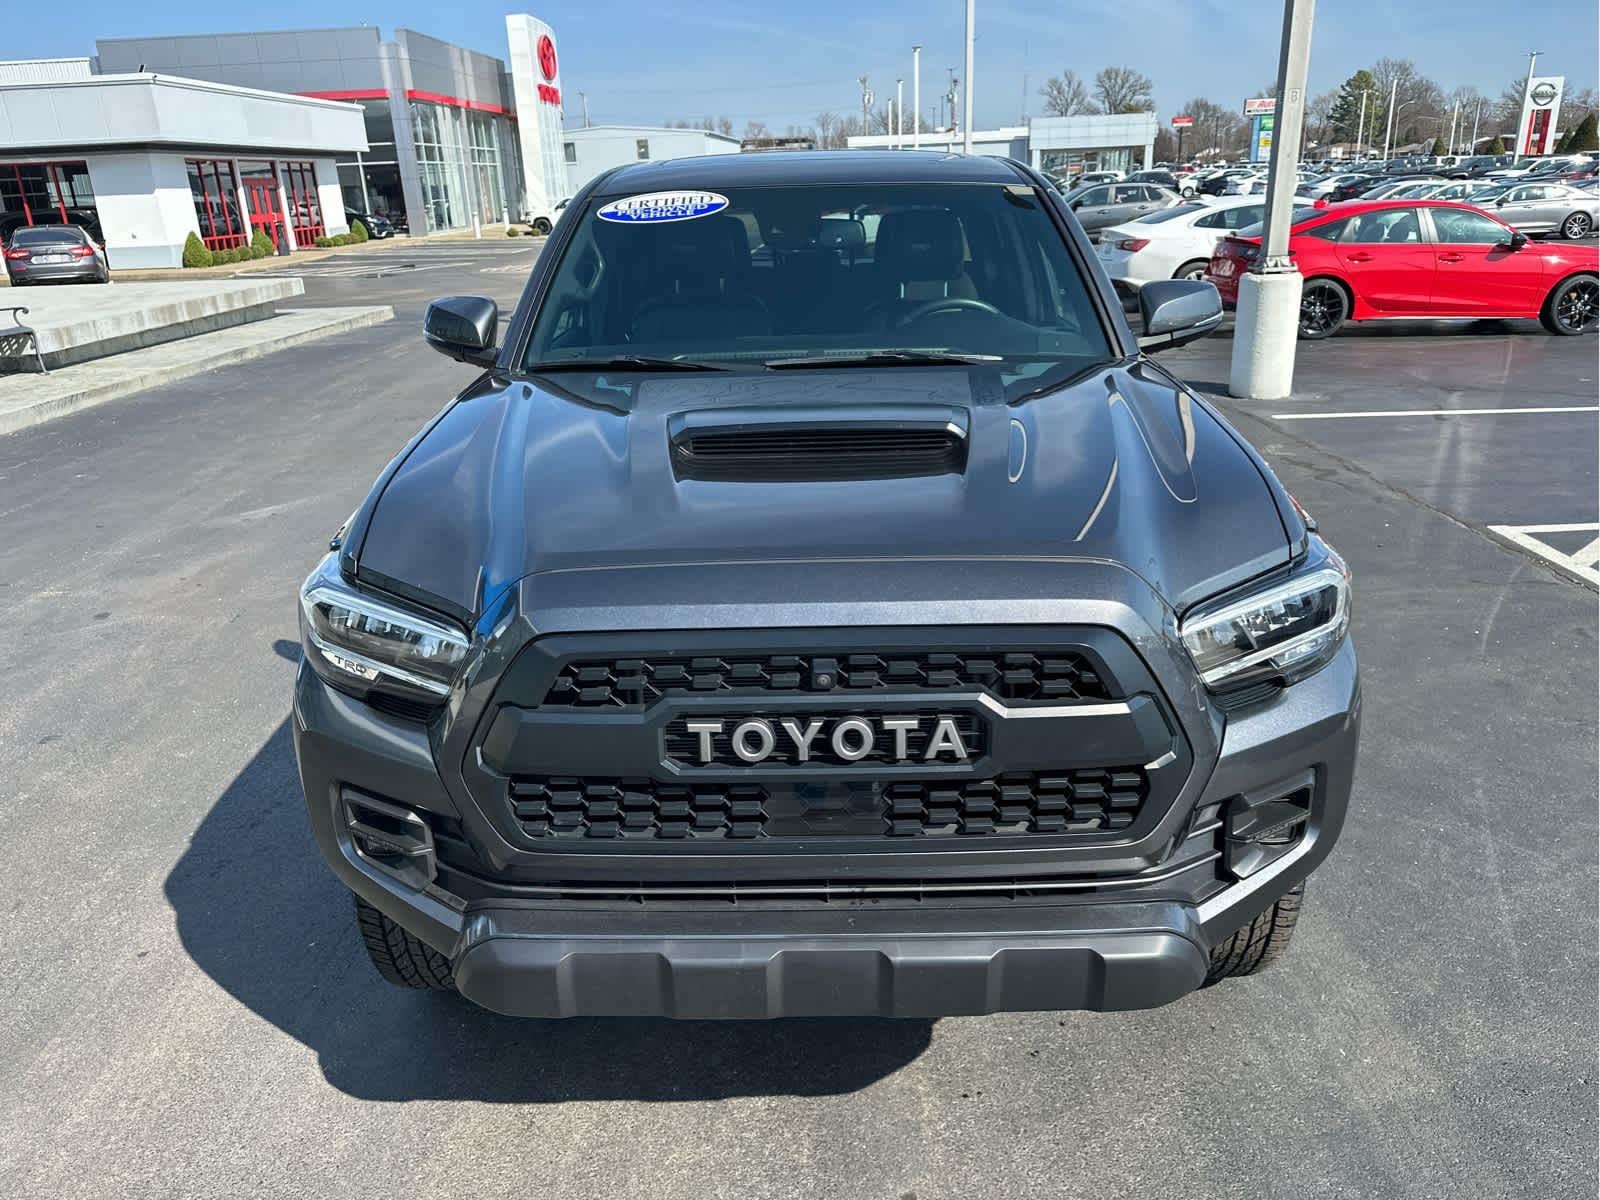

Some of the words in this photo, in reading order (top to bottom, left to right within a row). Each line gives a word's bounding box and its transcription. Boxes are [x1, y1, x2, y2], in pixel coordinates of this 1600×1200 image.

[614, 196, 714, 210] CERTIFIED
[630, 207, 695, 219] VEHICLE
[334, 655, 367, 674] TRD
[687, 716, 968, 762] TOYOTA
